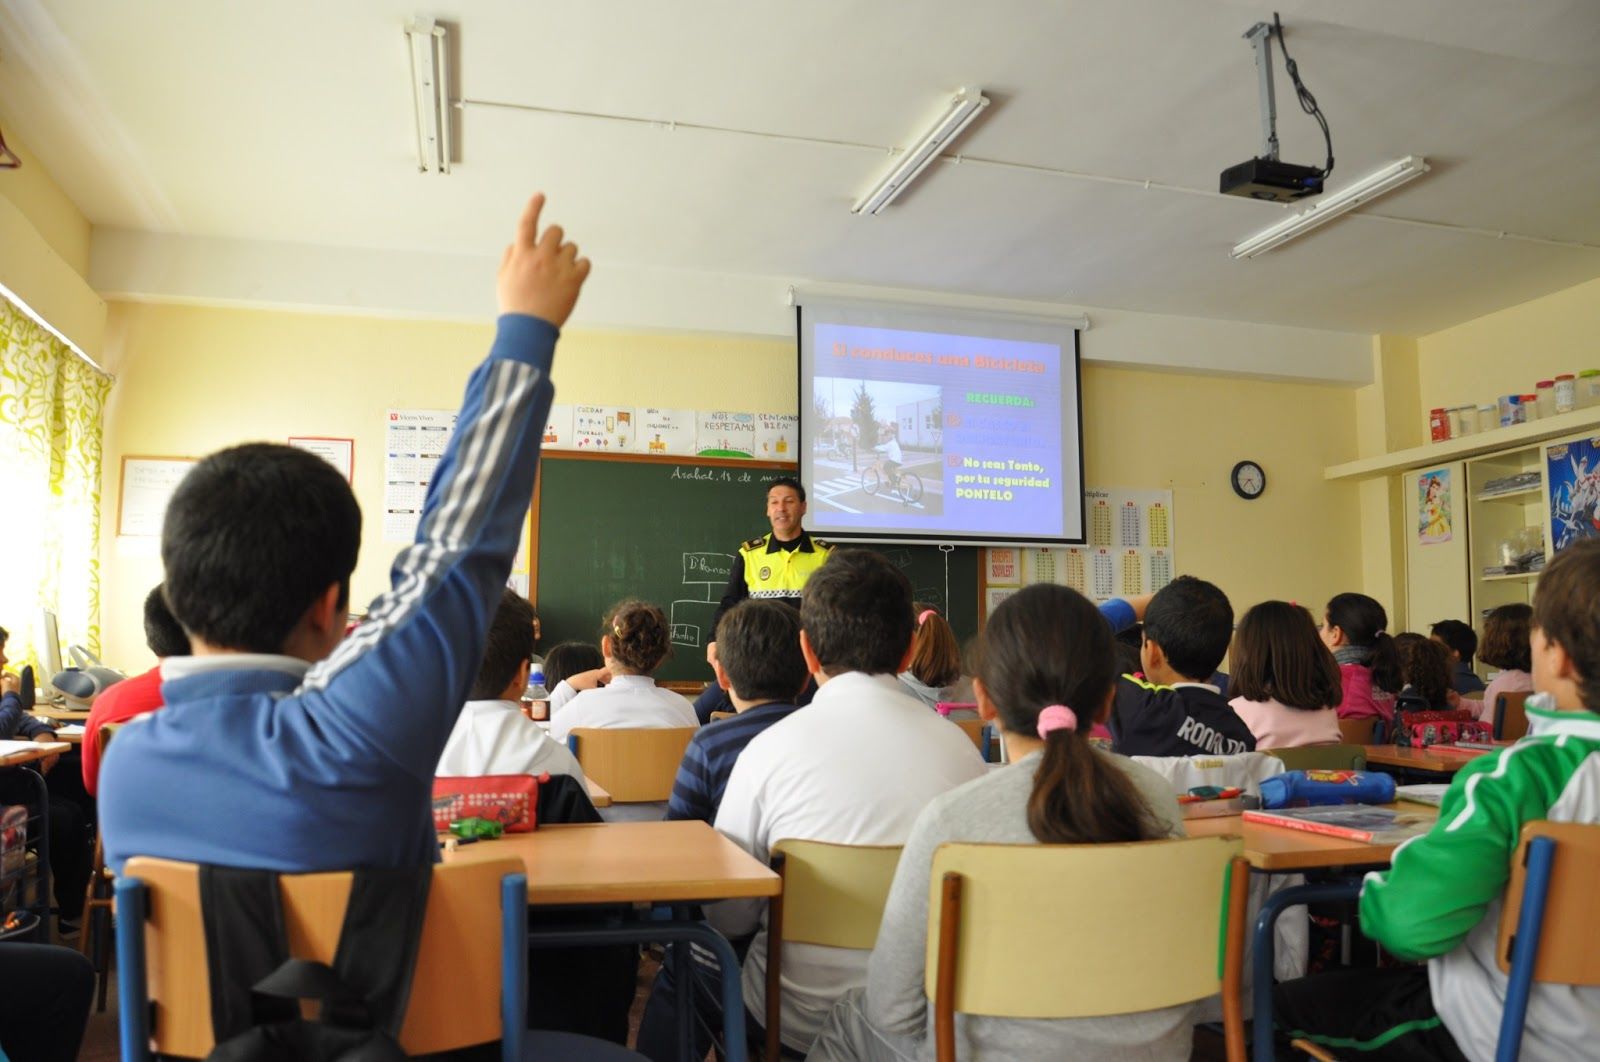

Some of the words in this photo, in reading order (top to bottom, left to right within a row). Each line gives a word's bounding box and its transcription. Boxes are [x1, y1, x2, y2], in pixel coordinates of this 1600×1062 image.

[938, 355, 970, 368] una
[974, 353, 1046, 374] Bicicleta
[963, 456, 981, 468] No
[982, 460, 1006, 471] seas
[1007, 459, 1045, 474] Tonto,
[738, 472, 752, 482] de
[955, 474, 976, 485] por
[977, 474, 991, 484] tu
[993, 476, 1051, 488] seguridad
[955, 487, 1013, 501] PONTELO
